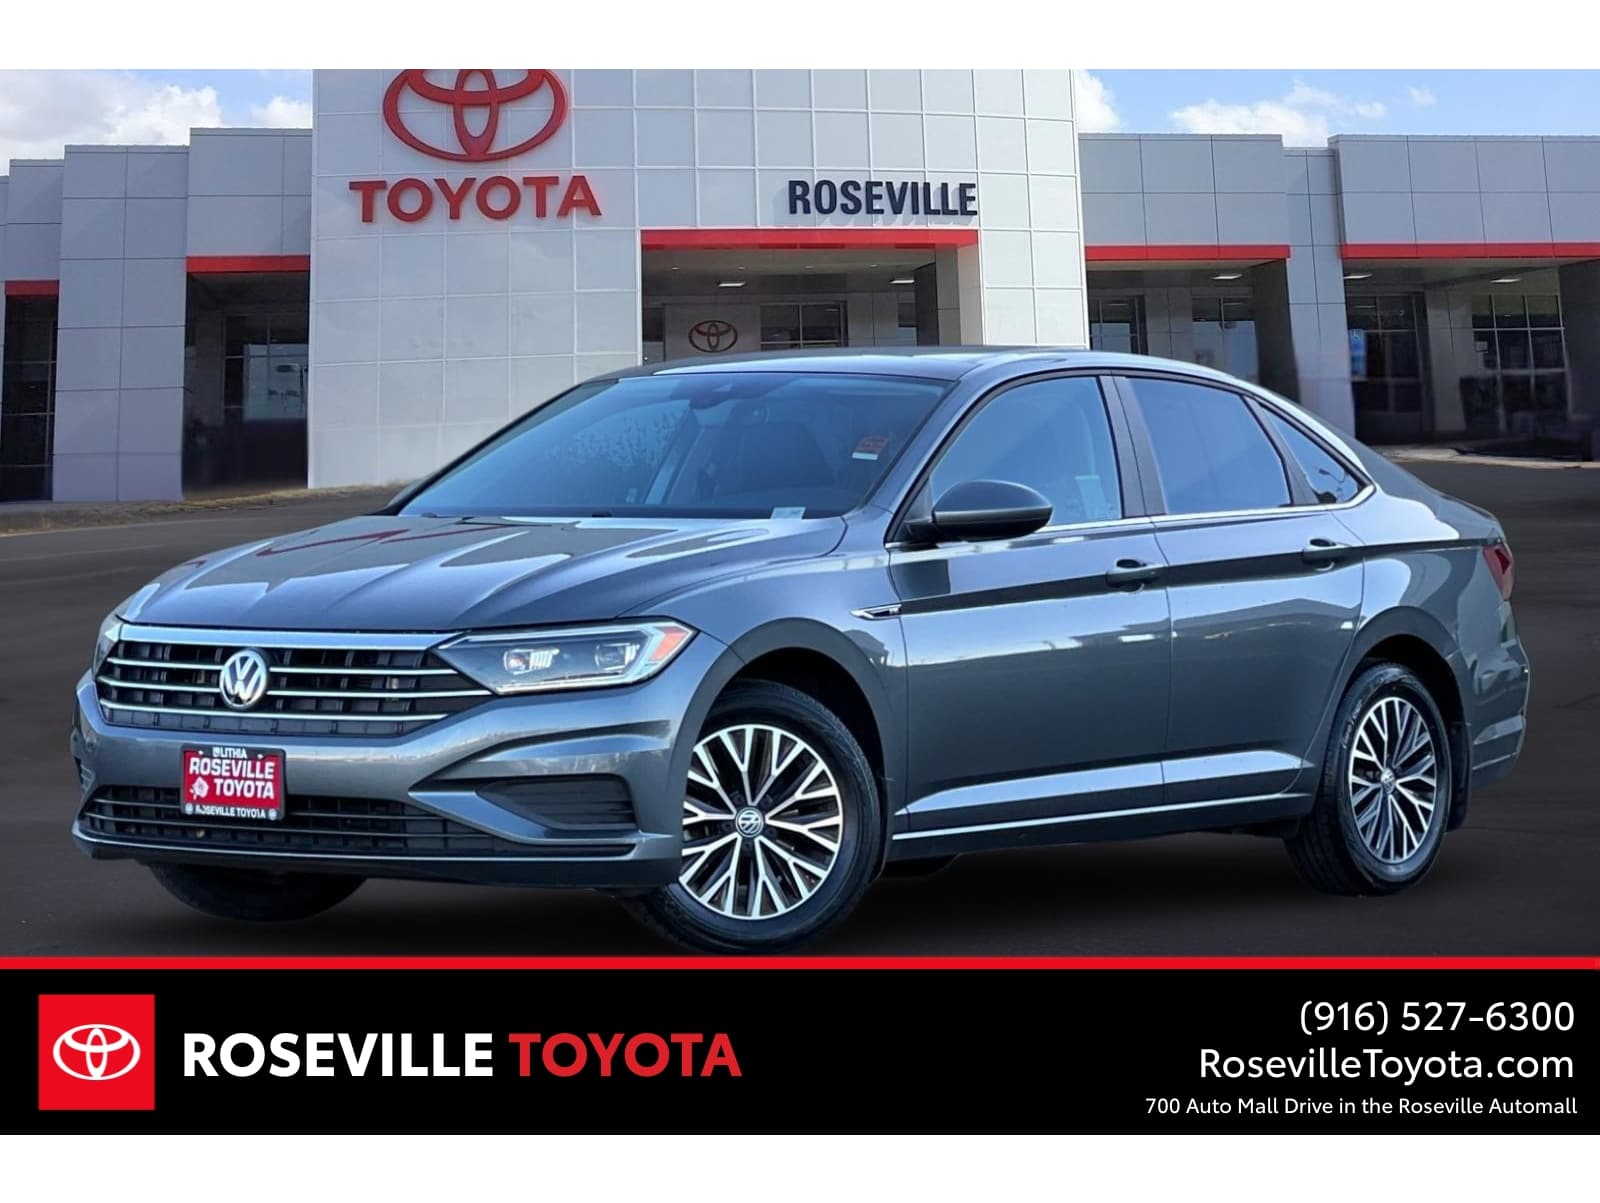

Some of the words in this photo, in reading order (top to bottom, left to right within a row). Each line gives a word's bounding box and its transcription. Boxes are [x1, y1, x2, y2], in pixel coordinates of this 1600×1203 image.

[349, 175, 602, 223] TOYOTA
[788, 180, 978, 216] ROSEVILLE
[189, 757, 275, 780] ROSEVILLE
[213, 778, 275, 800] TOYOTA
